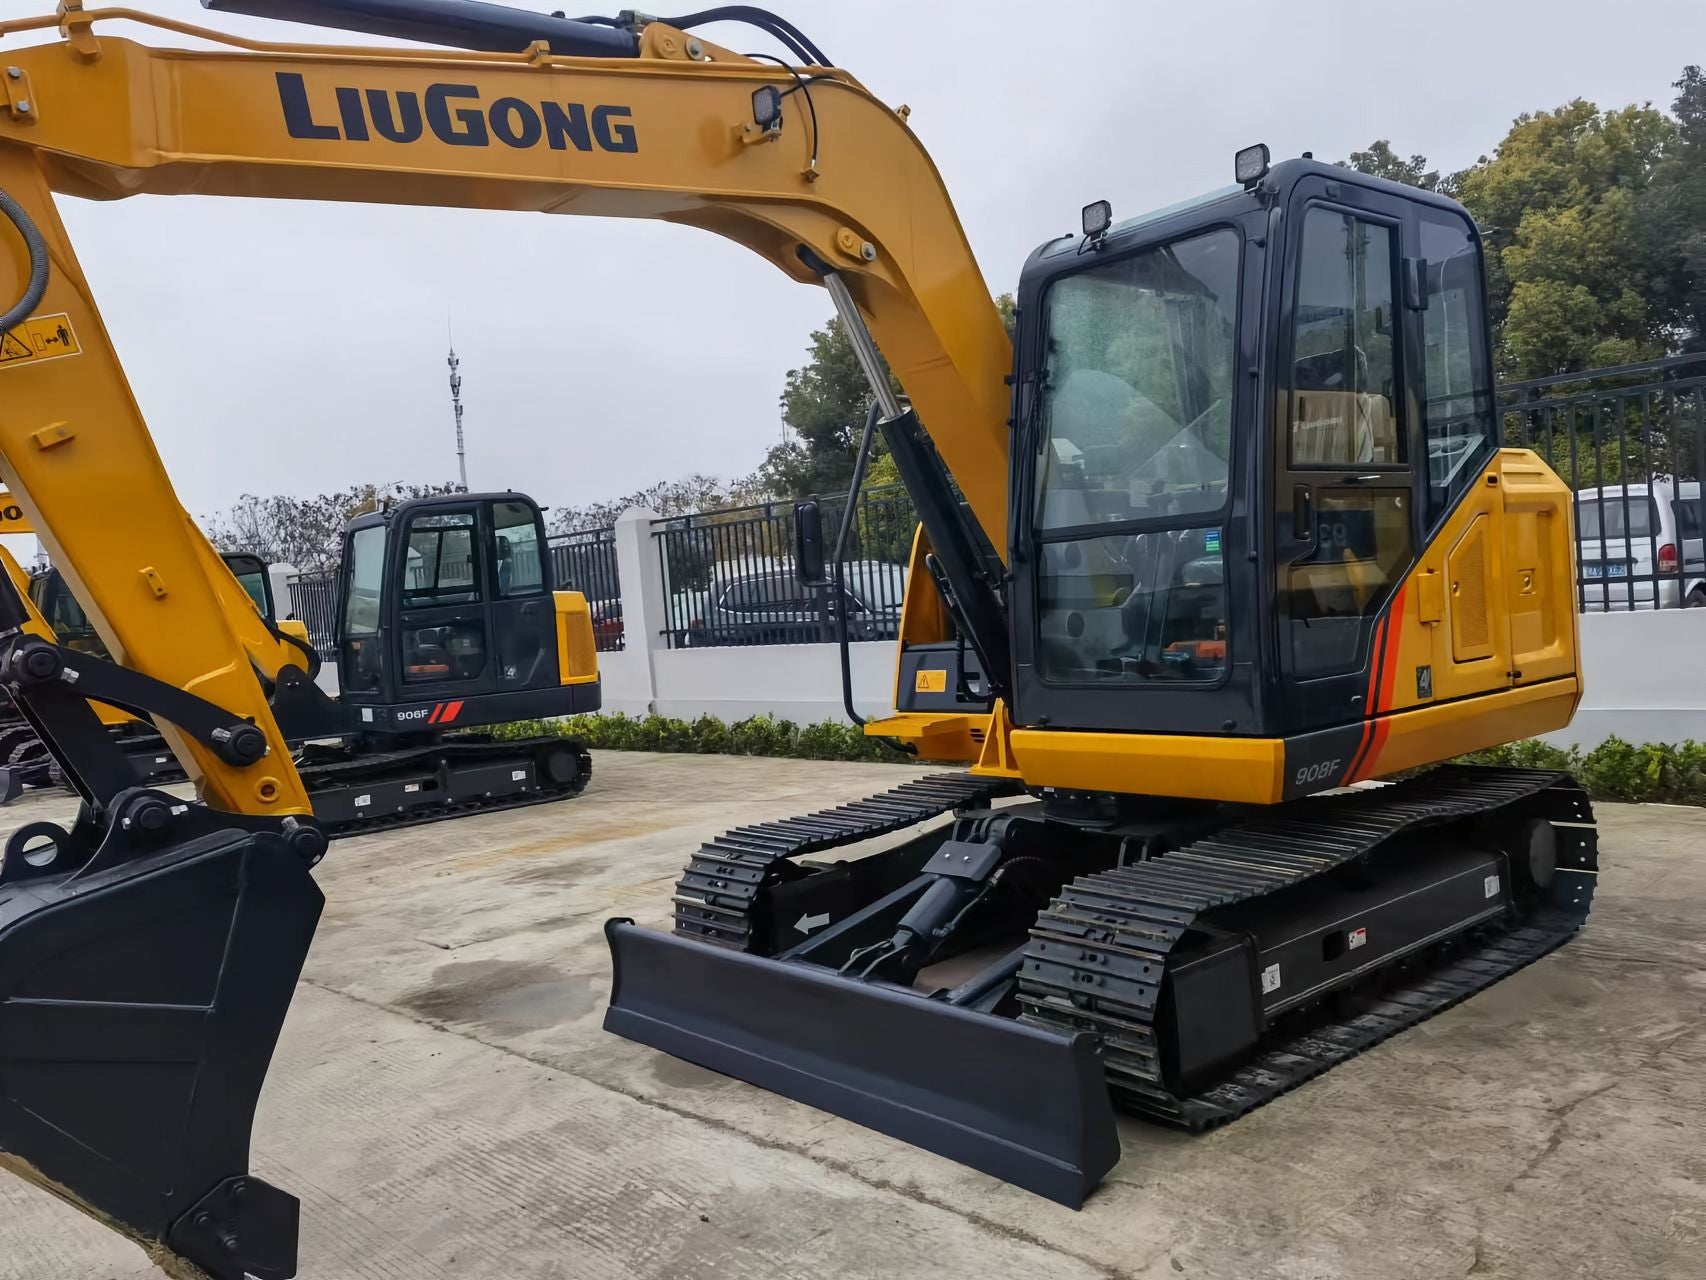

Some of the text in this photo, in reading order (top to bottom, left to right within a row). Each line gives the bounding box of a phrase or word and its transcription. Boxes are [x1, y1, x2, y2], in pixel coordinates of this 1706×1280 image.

[275, 71, 638, 153] LIUGONG
[397, 709, 429, 720] 906F
[1295, 758, 1341, 785] 908F
